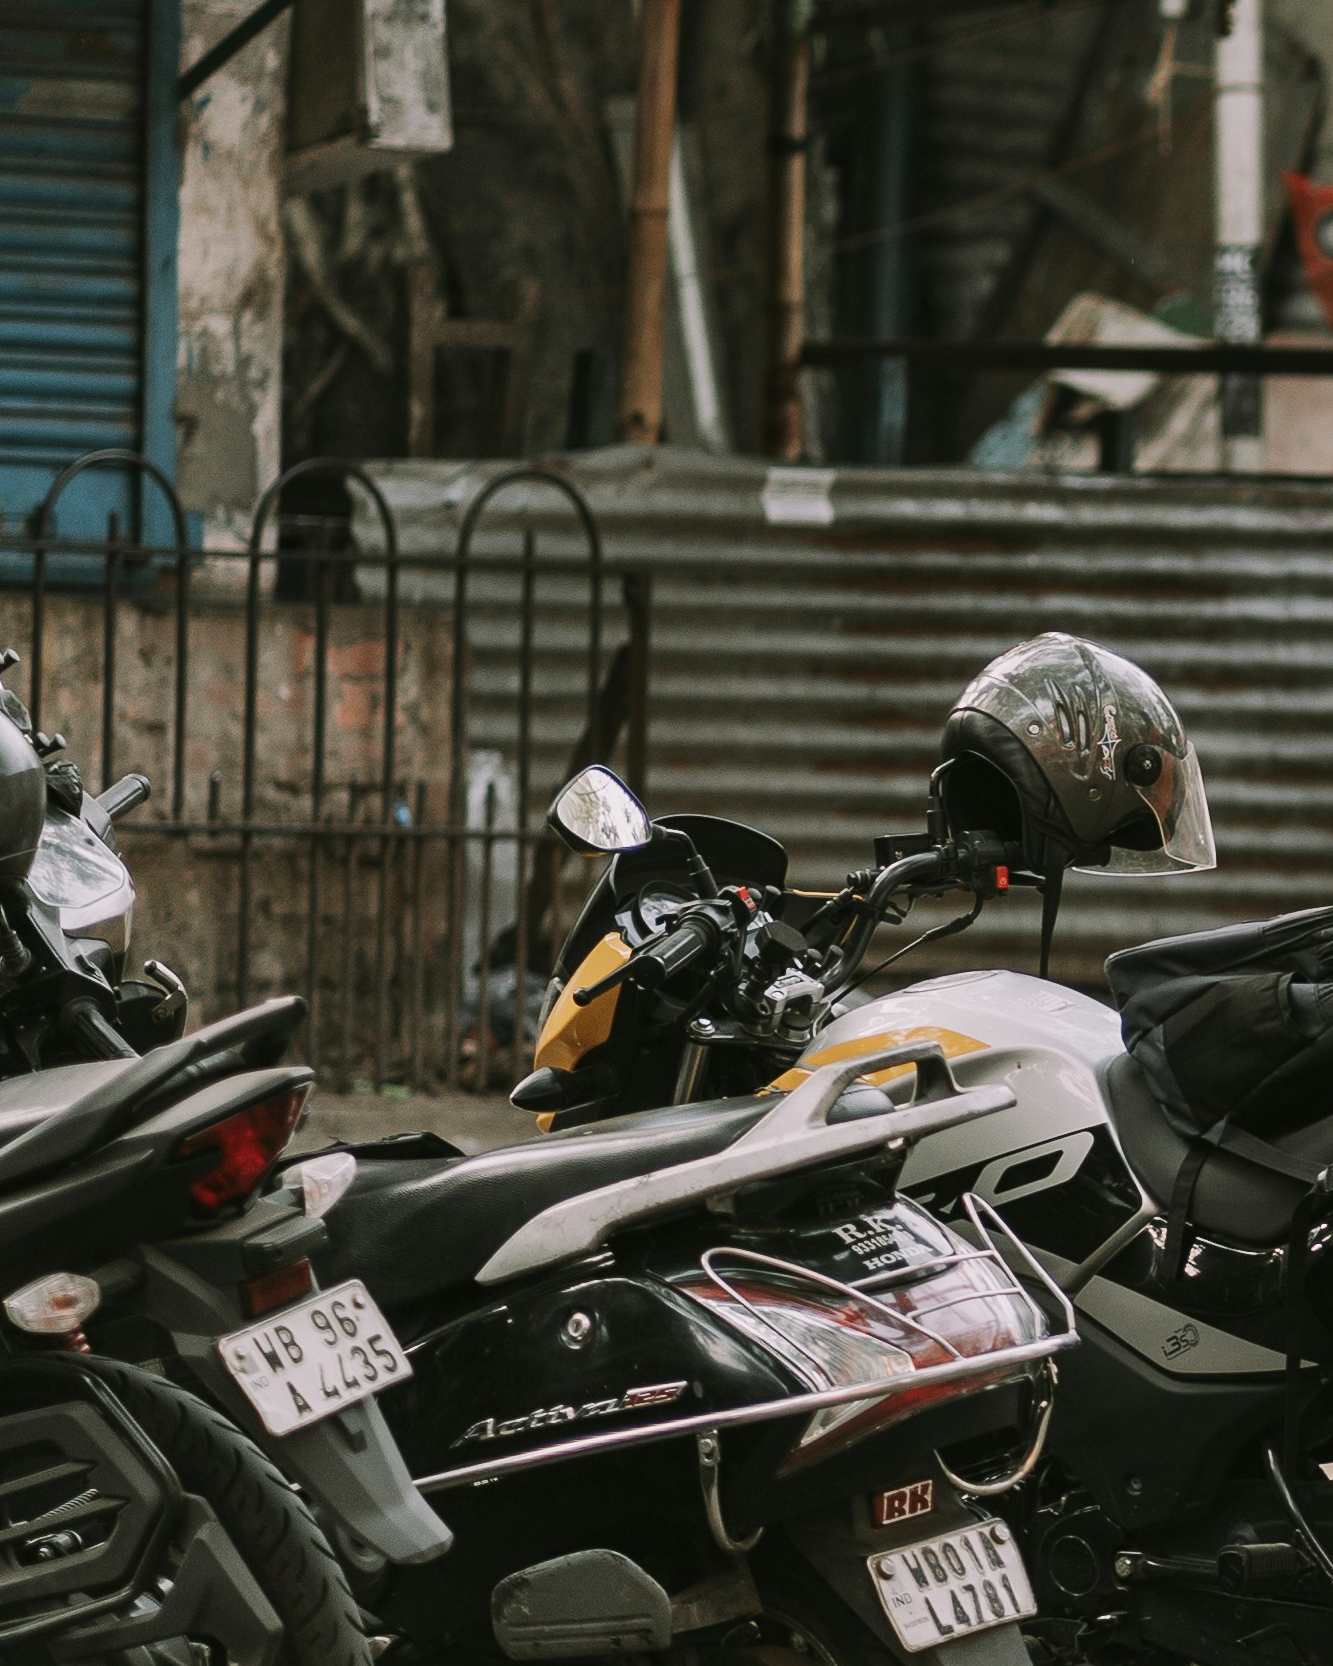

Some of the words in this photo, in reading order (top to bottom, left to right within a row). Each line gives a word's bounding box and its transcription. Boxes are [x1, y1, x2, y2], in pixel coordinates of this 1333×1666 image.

[862, 1243, 934, 1271] HONDA
[252, 1325, 304, 1375] WB
[310, 1299, 358, 1347] 96
[884, 1482, 931, 1523] RK
[900, 1529, 1007, 1593] WB01A
[924, 1572, 1021, 1637] L4781
